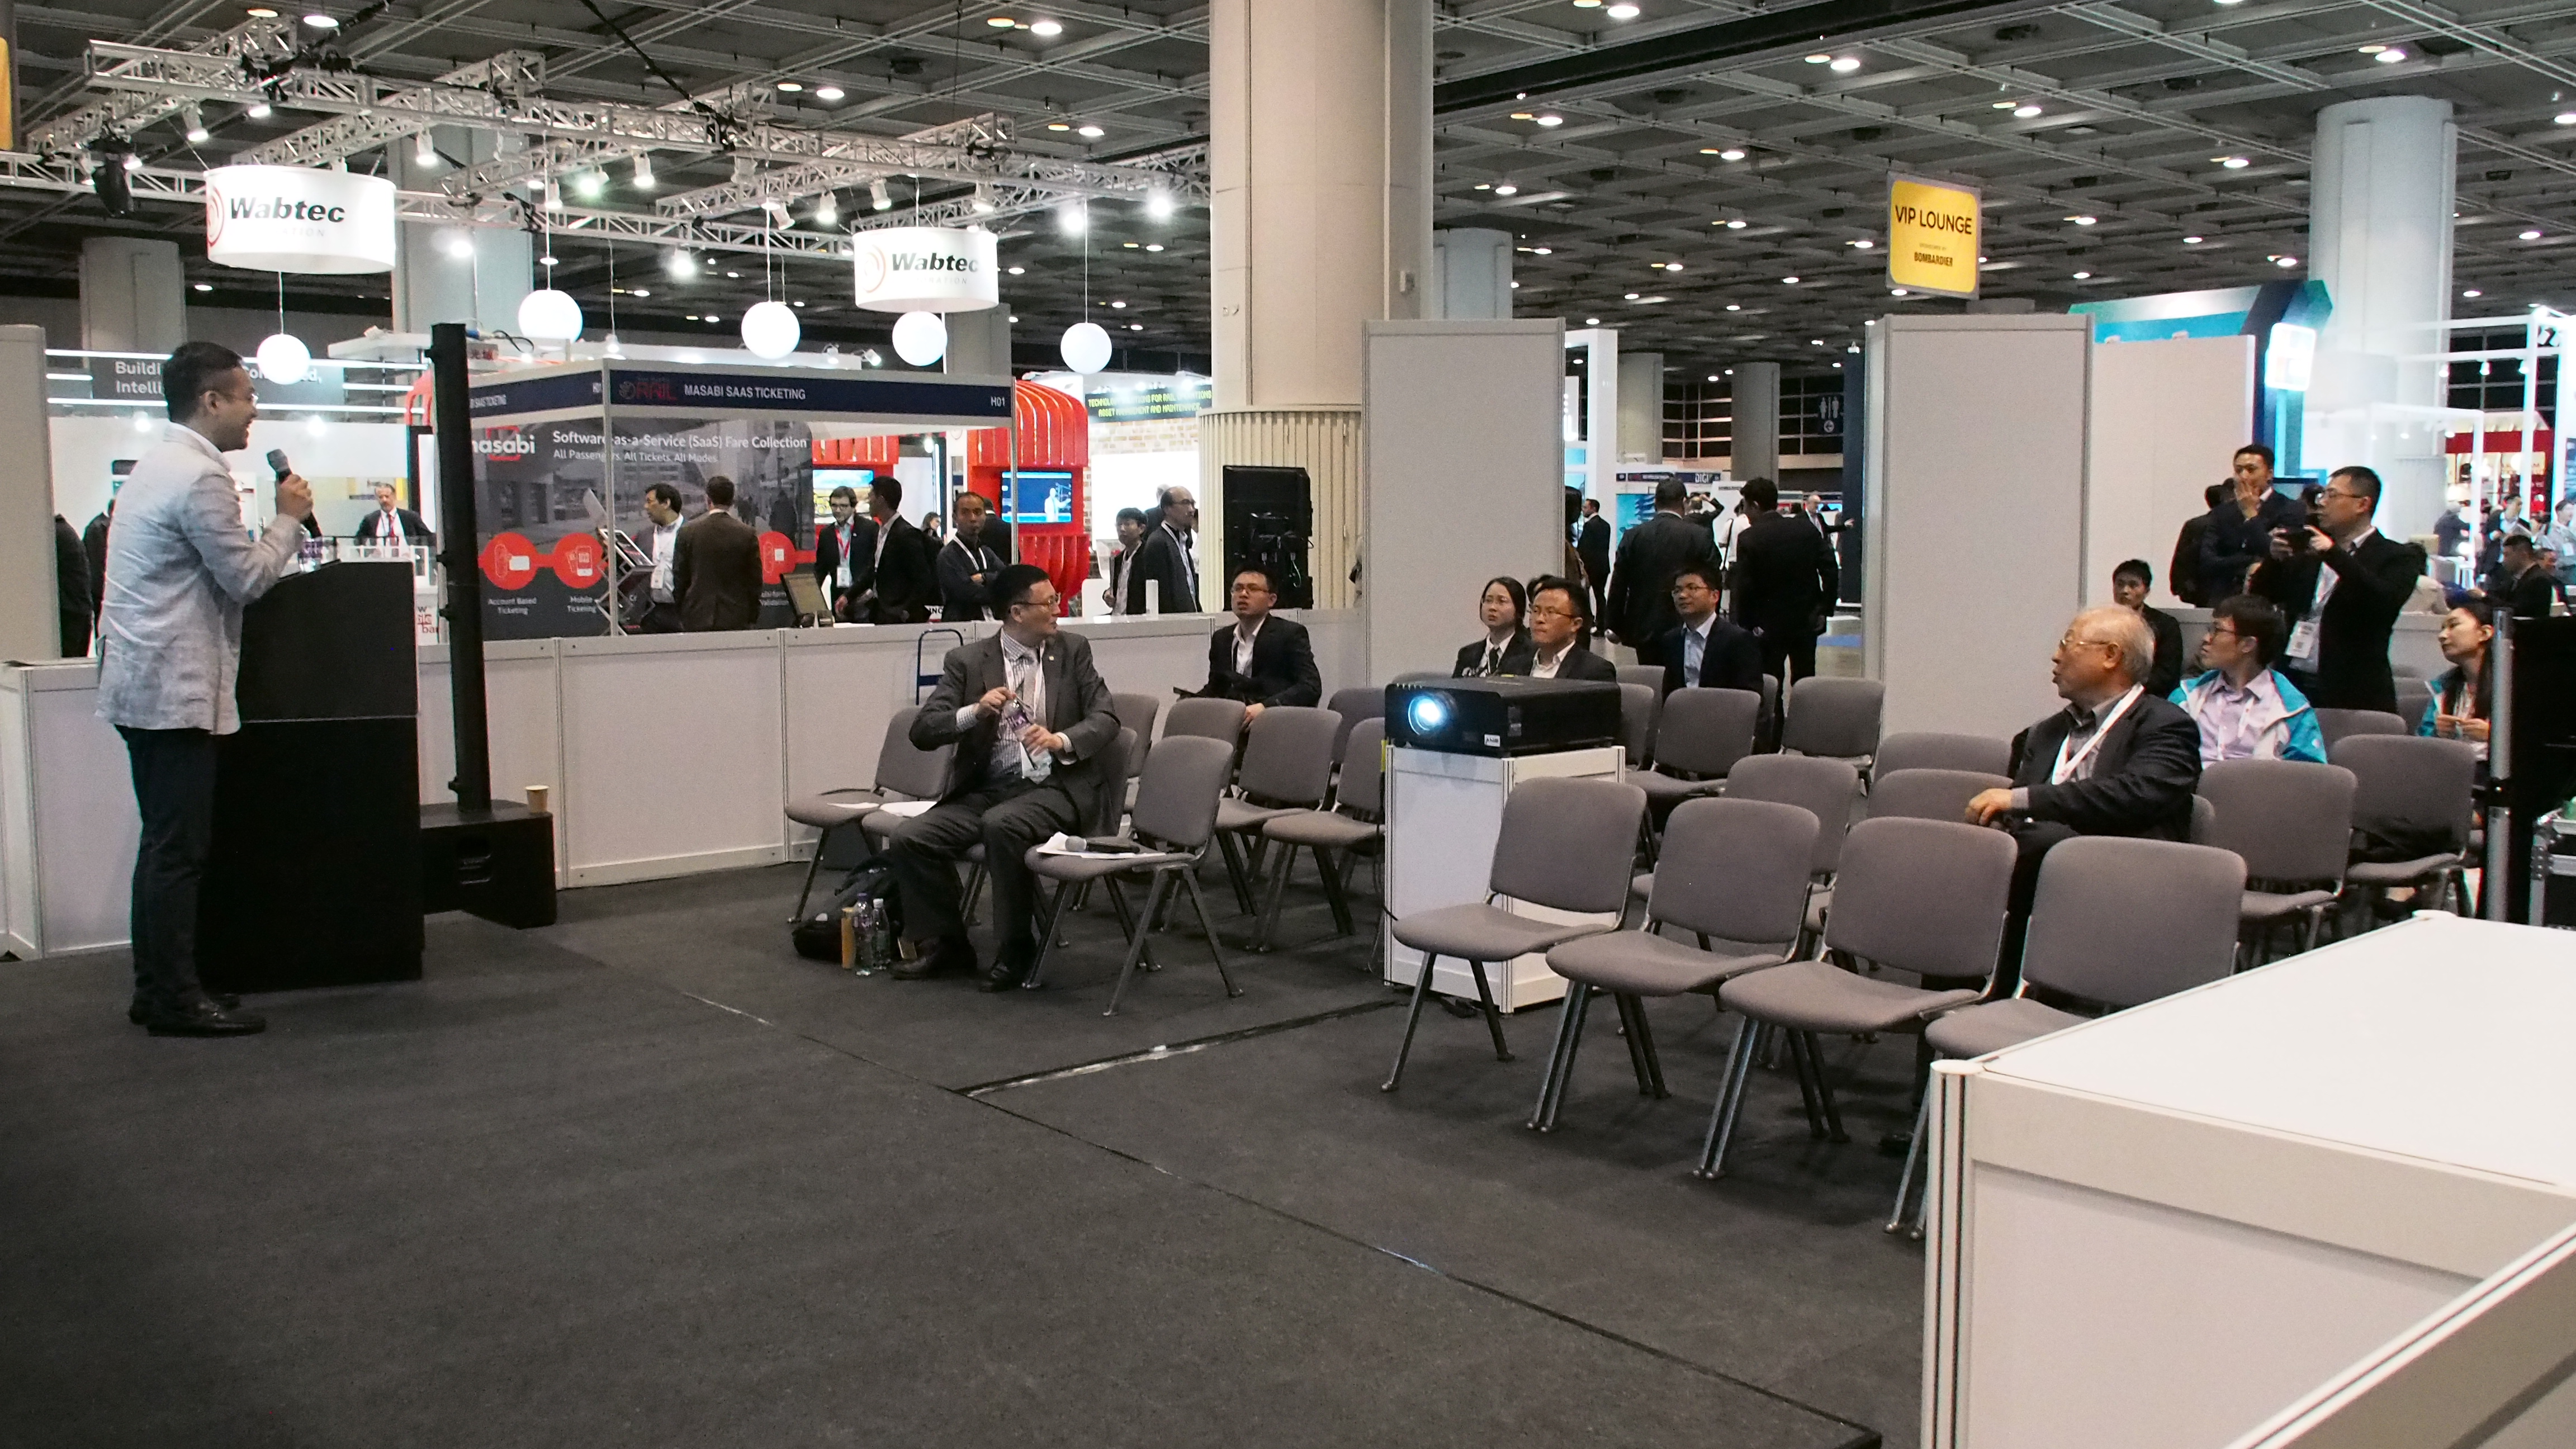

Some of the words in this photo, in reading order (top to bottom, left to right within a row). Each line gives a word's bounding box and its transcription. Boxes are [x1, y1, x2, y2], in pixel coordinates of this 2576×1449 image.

[230, 197, 345, 223] Wabtec
[1895, 205, 1916, 225] VIP
[1920, 209, 1972, 235] LOUNGE
[892, 252, 979, 273] Wabtec
[1914, 252, 1953, 267] BOMBARDIER
[684, 384, 724, 396] MASABI
[727, 385, 753, 398] SAAS
[755, 386, 806, 400] TICKETING
[1151, 394, 1163, 403] FOR
[991, 396, 1005, 407] H01
[1150, 404, 1162, 414] AND
[689, 434, 722, 448] (SaaS)
[726, 436, 749, 448] Fare
[751, 435, 807, 448] Collection
[553, 449, 566, 458] All
[624, 452, 637, 462] All
[674, 453, 686, 463] All
[688, 453, 719, 463] Modes
